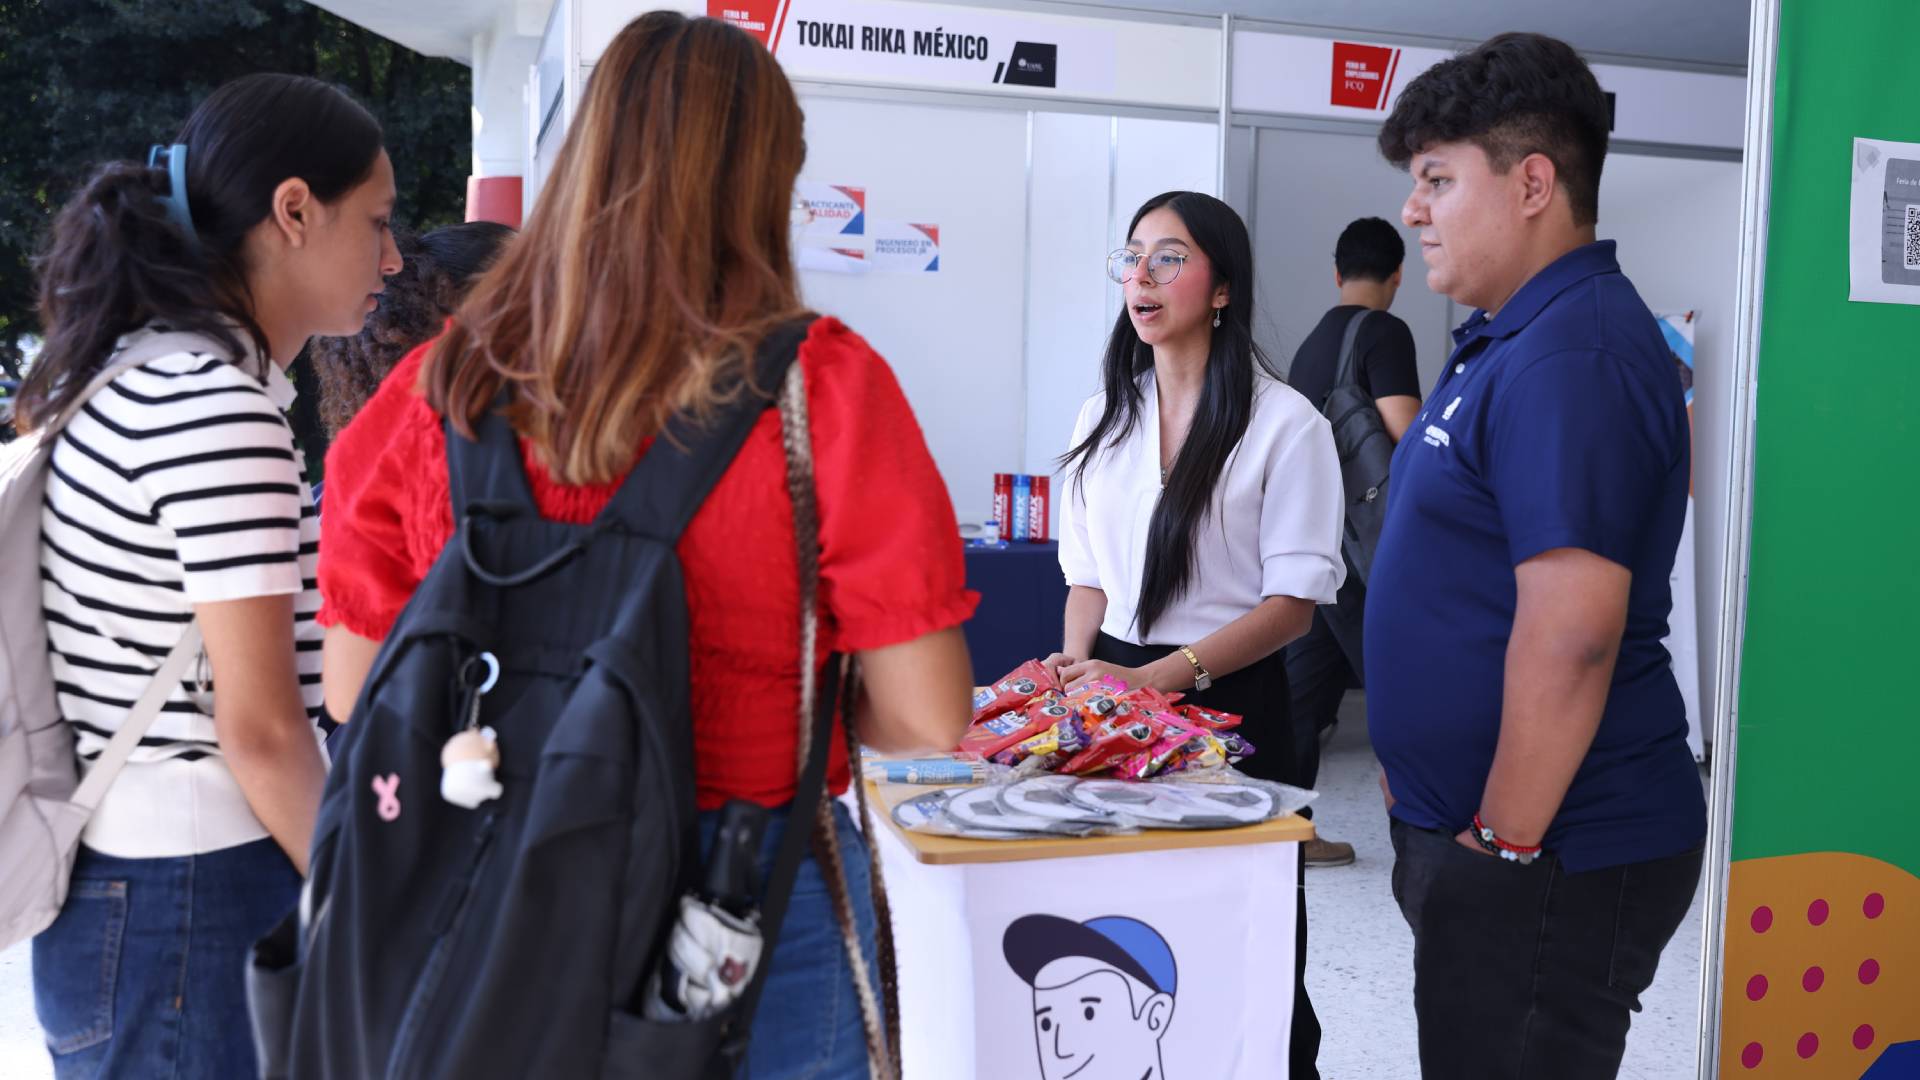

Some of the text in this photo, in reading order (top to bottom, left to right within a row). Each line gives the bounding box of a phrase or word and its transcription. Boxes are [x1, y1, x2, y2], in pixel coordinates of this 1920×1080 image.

[797, 20, 988, 61] TOKAI RIKA MÉXICO
[1345, 80, 1364, 92] FCQ
[808, 208, 851, 219] ALIDAD
[875, 238, 932, 247] INGENIERO EN
[1029, 495, 1039, 539] TRMX
